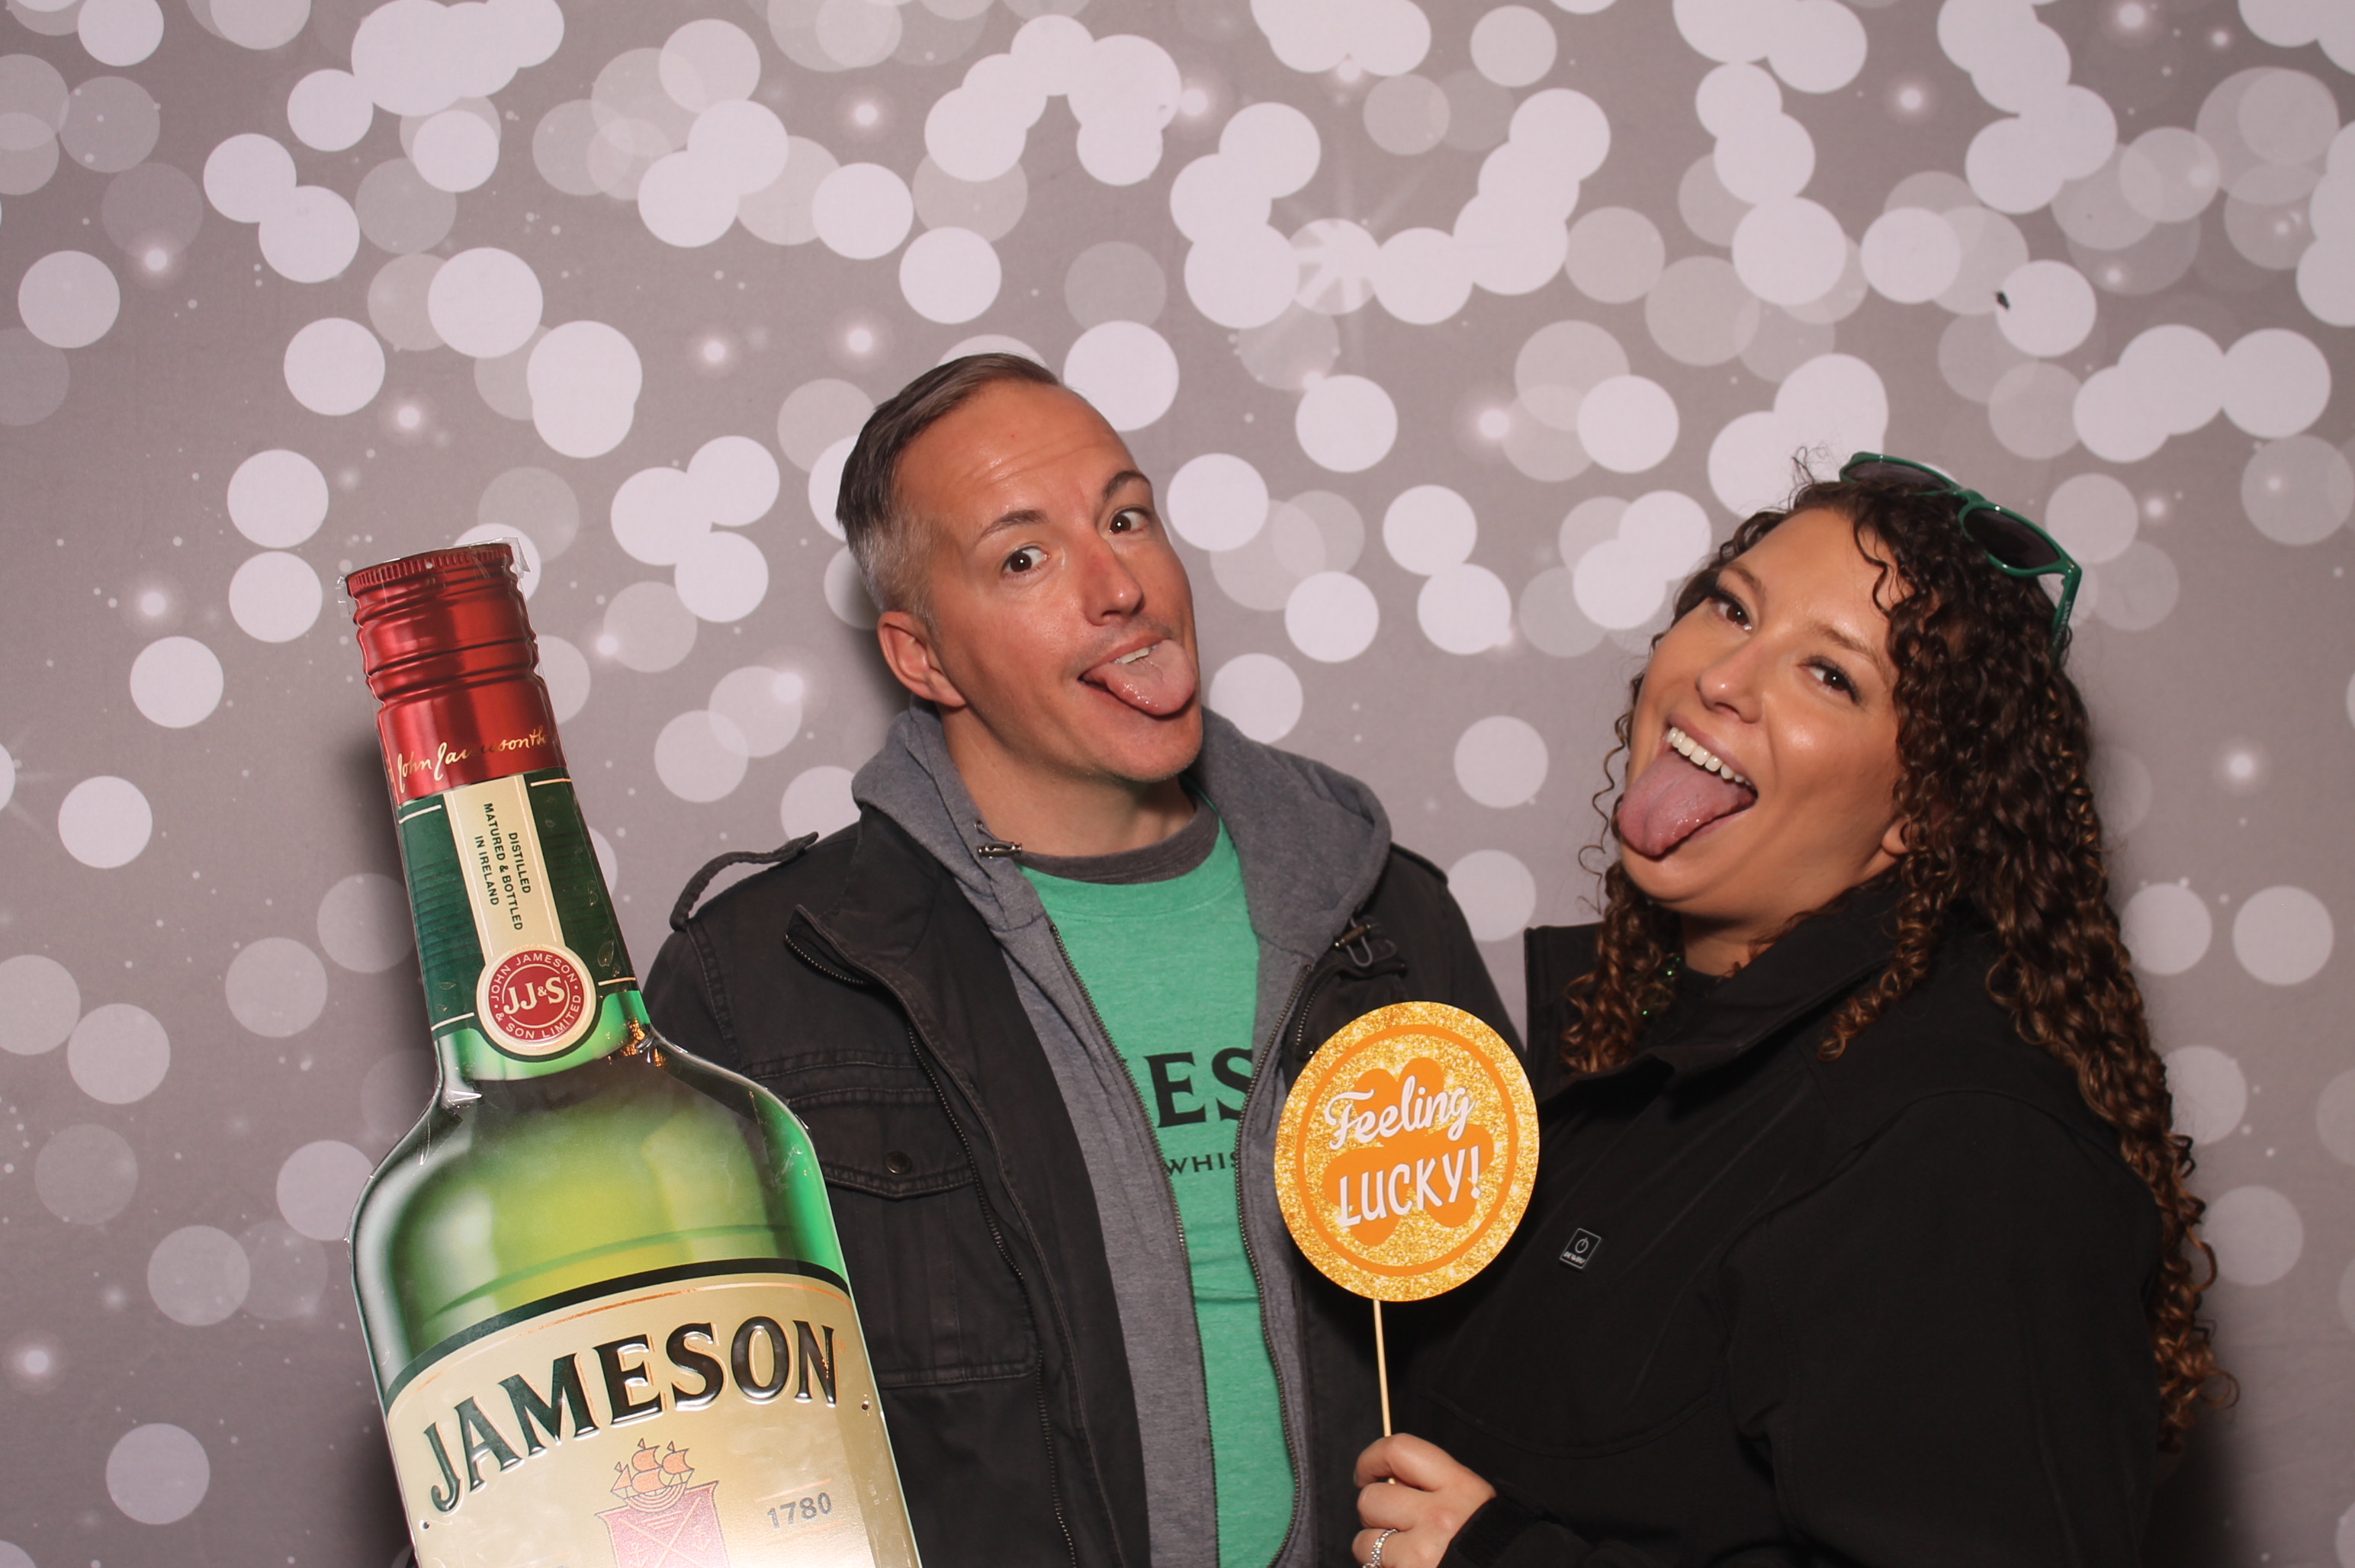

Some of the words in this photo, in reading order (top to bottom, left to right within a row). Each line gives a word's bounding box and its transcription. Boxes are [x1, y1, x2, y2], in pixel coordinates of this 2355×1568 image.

[474, 835, 485, 848] IN
[484, 802, 506, 861] MATURED
[502, 875, 523, 930] BOTTLED
[509, 832, 531, 894] DISTILLED
[478, 851, 500, 906] IRELAND
[490, 965, 512, 1001] JOHN
[516, 953, 577, 983] JAMESON
[503, 976, 565, 1014] JJ&S
[495, 1012, 504, 1022] &
[506, 1023, 535, 1039] SON
[541, 994, 581, 1038] LIMITED
[1123, 1047, 1253, 1128] ES
[1325, 1075, 1476, 1150] Feeling
[1335, 1145, 1481, 1228] LUCKY!
[424, 1315, 838, 1514] JAMESON
[767, 1492, 832, 1530] 1780
